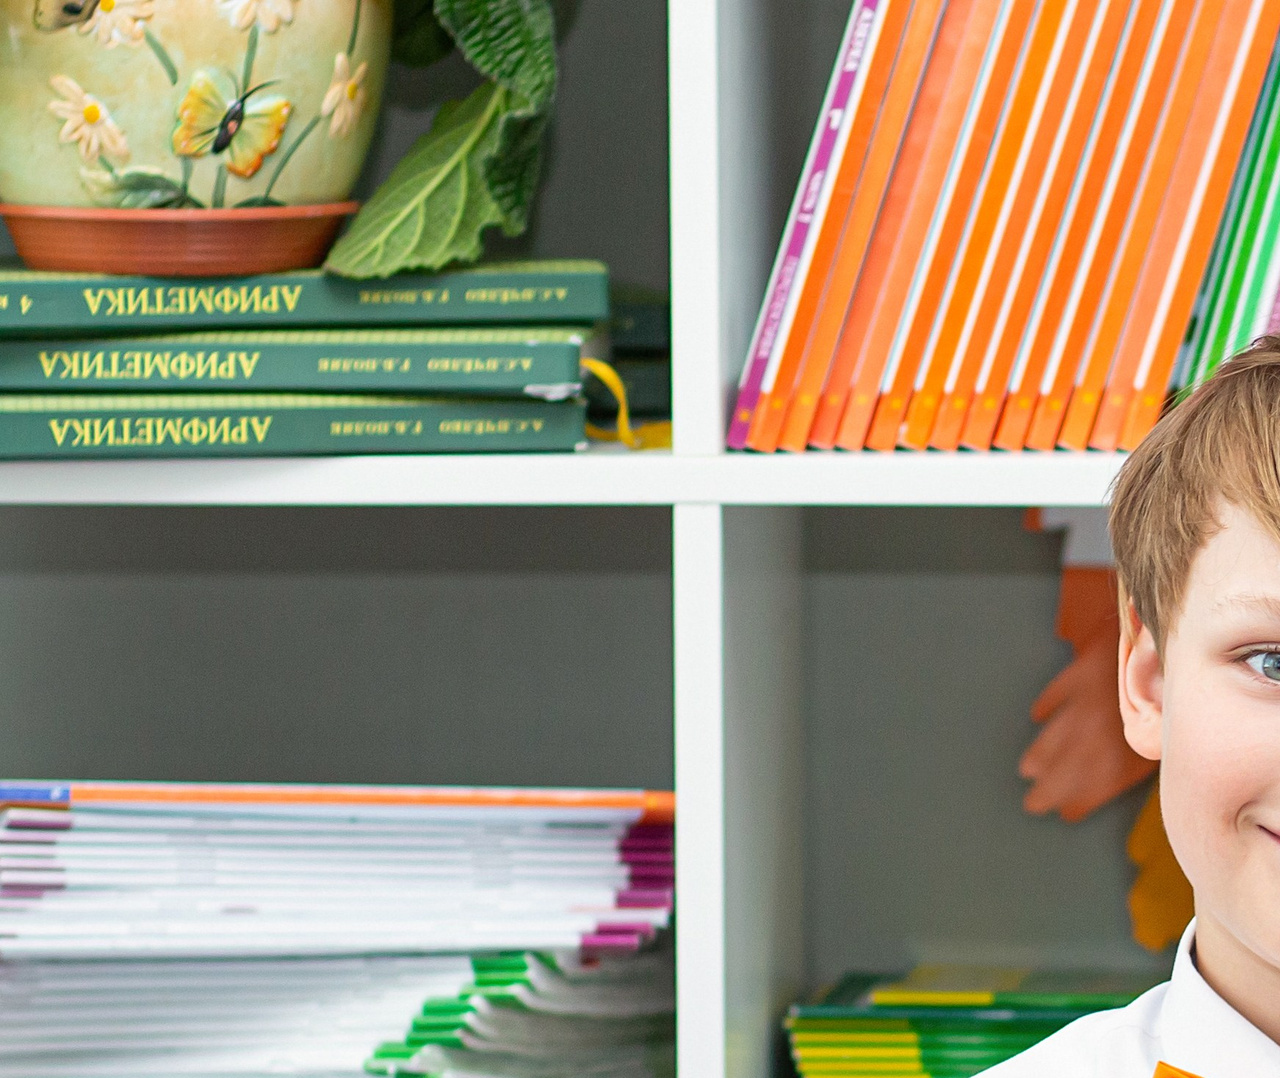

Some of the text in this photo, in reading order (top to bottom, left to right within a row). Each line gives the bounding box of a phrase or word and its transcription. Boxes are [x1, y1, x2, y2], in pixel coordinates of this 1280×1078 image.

[83, 285, 302, 316] АРИФМЕТИКА
[38, 350, 260, 379] АРИФМЕТИКА
[49, 416, 272, 446] АРИФМЕТИКА
